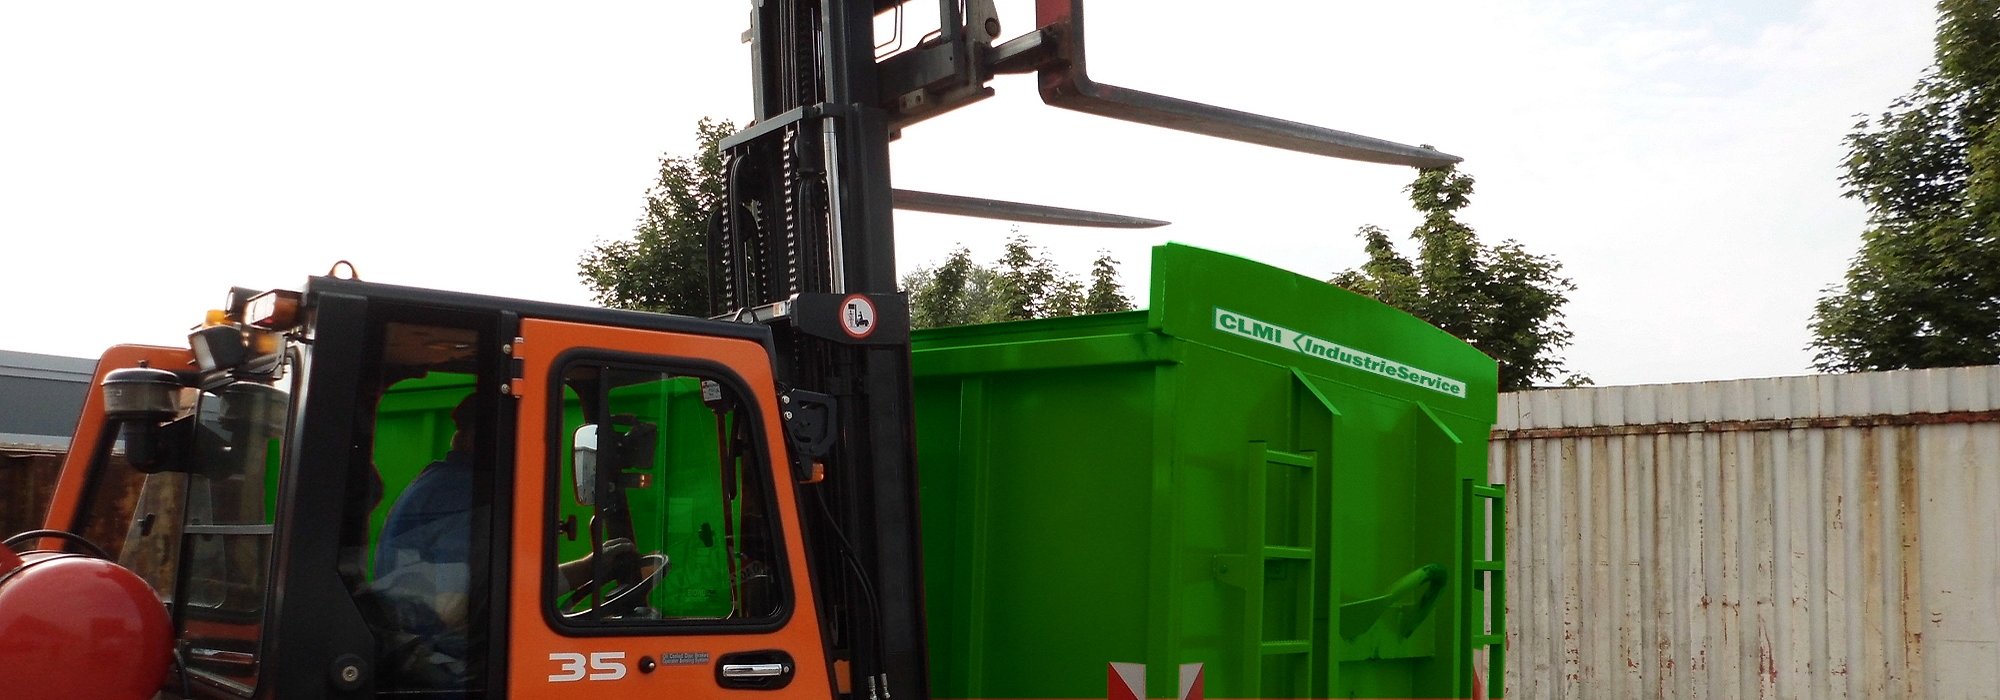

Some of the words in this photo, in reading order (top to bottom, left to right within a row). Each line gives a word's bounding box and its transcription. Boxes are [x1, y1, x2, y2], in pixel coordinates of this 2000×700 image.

[1219, 313, 1282, 344] CLMI
[1304, 338, 1461, 395] IndustrieService
[548, 652, 627, 682] 35
